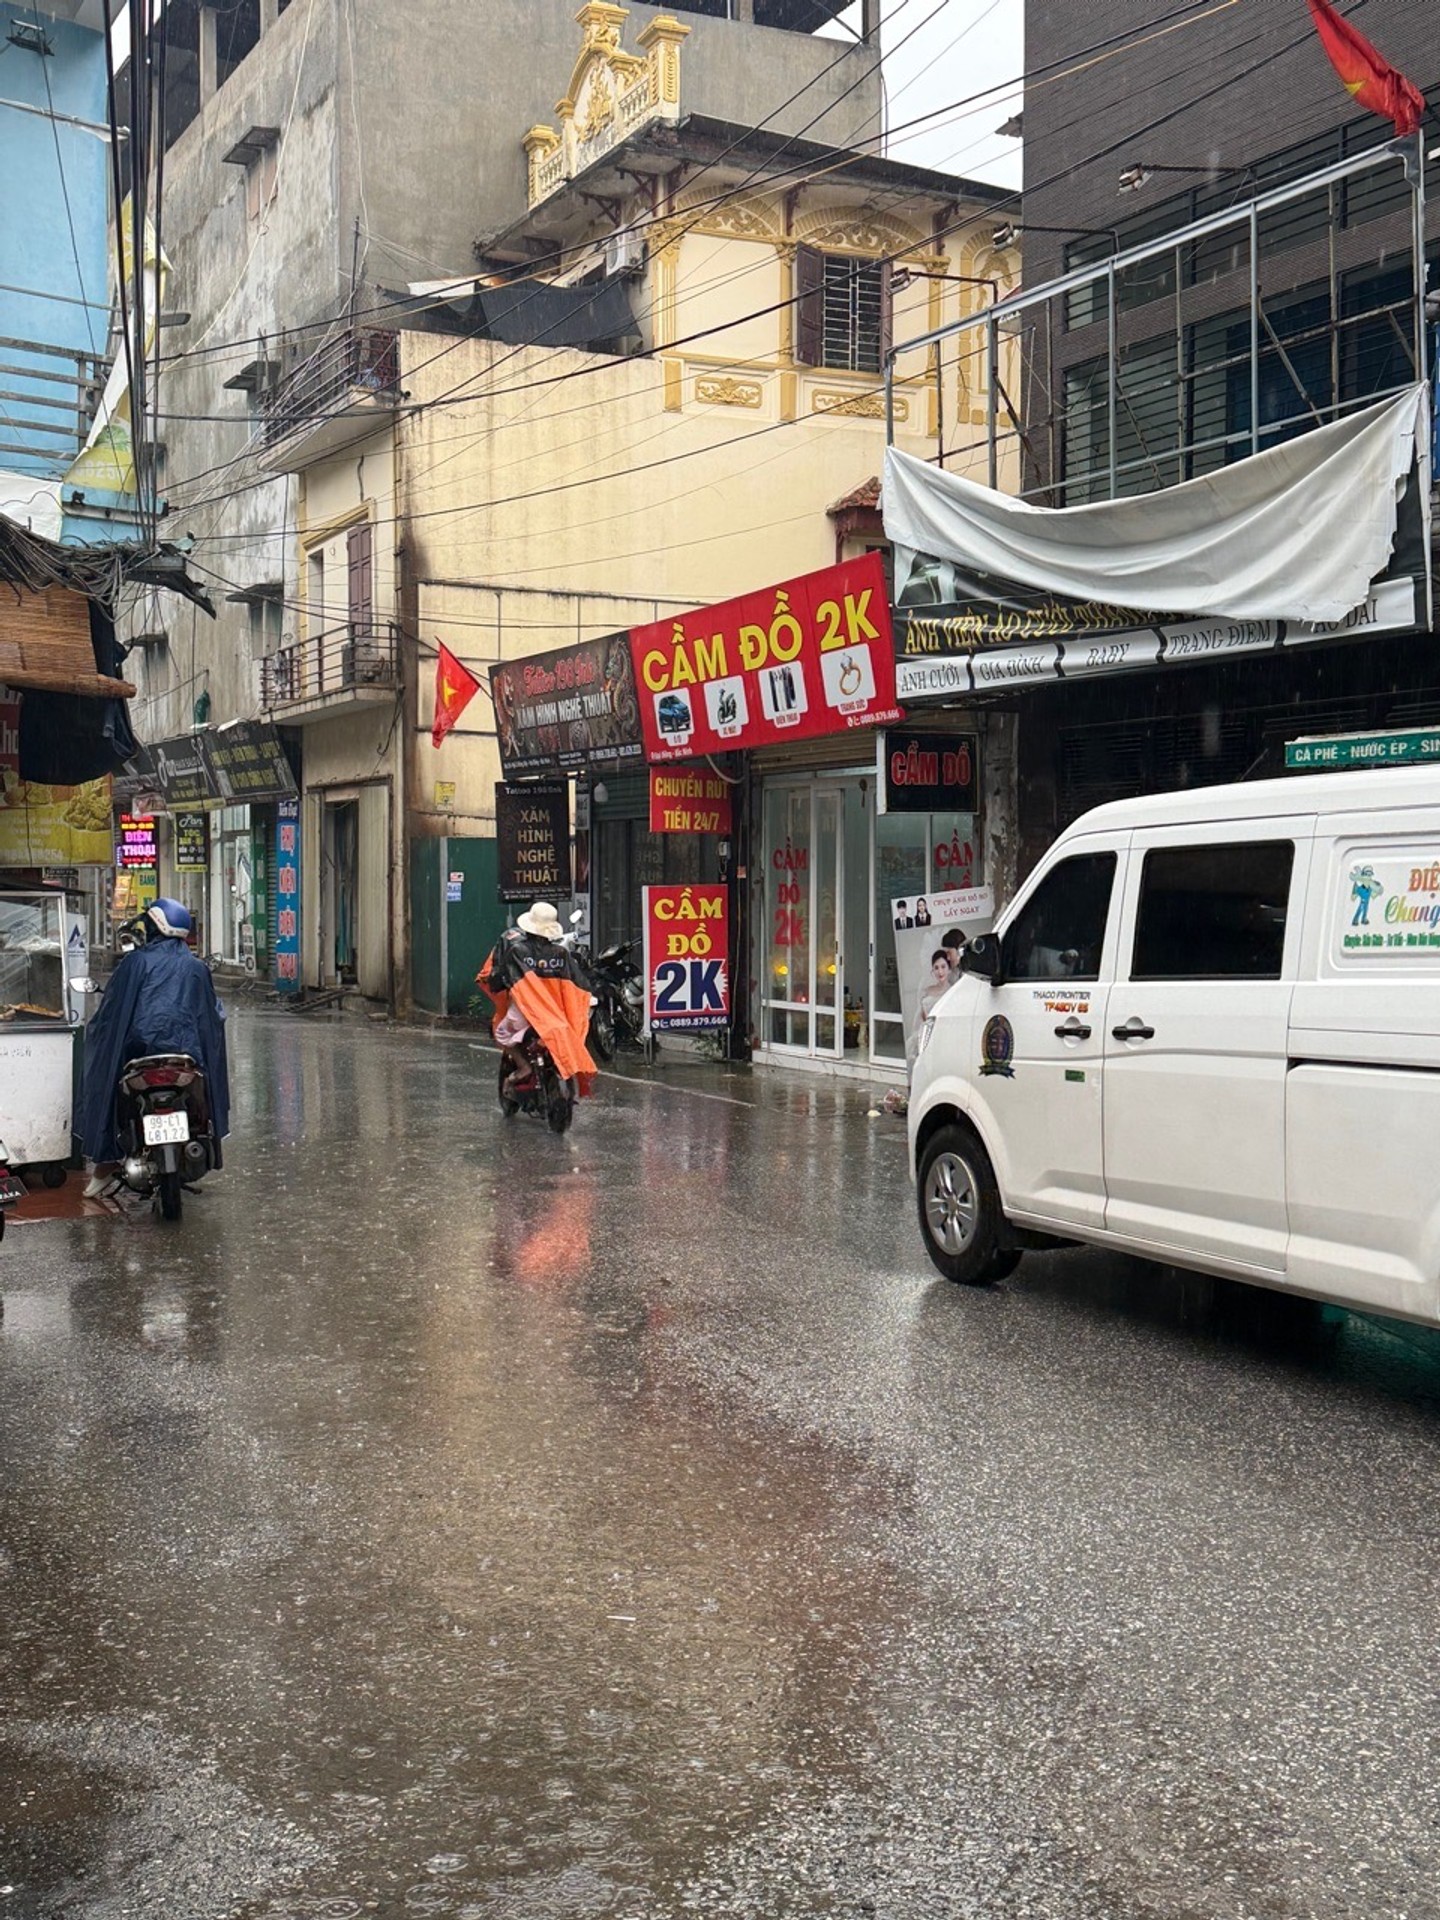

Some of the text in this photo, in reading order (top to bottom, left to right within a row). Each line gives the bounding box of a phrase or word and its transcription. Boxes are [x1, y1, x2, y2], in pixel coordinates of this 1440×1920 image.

[905, 608, 941, 654] ẢNH
[943, 606, 988, 654] VIỆN
[988, 603, 1020, 642] ÁO
[1020, 599, 1074, 640] CƯỚI
[642, 588, 881, 693] CẦM ĐỒ 2K
[1170, 629, 1224, 656] TRANG
[979, 652, 1045, 681] GIA ĐÌNH
[1086, 643, 1130, 667] BABY
[901, 664, 960, 692] ẢNH CƯỚI
[1295, 747, 1311, 762] CÀ
[1314, 744, 1338, 760] PHÊ
[1351, 743, 1386, 757] NƯỚC
[1390, 740, 1408, 755] ÉP
[655, 771, 729, 799] CHUYỂN RÚT
[520, 805, 551, 823] XĂM
[663, 804, 720, 831] TIỀN 24/7
[517, 825, 554, 843] HÌNH
[122, 844, 156, 857] THOẠI
[517, 844, 557, 865] NGHỆ
[773, 836, 808, 870] CẦM
[513, 865, 560, 886] THUẬT
[653, 887, 724, 920] CẦM
[666, 922, 712, 956] ĐỒ
[655, 959, 725, 1012] 2K
[1033, 991, 1055, 999] THACO
[670, 1016, 728, 1027] 0889.879.666
